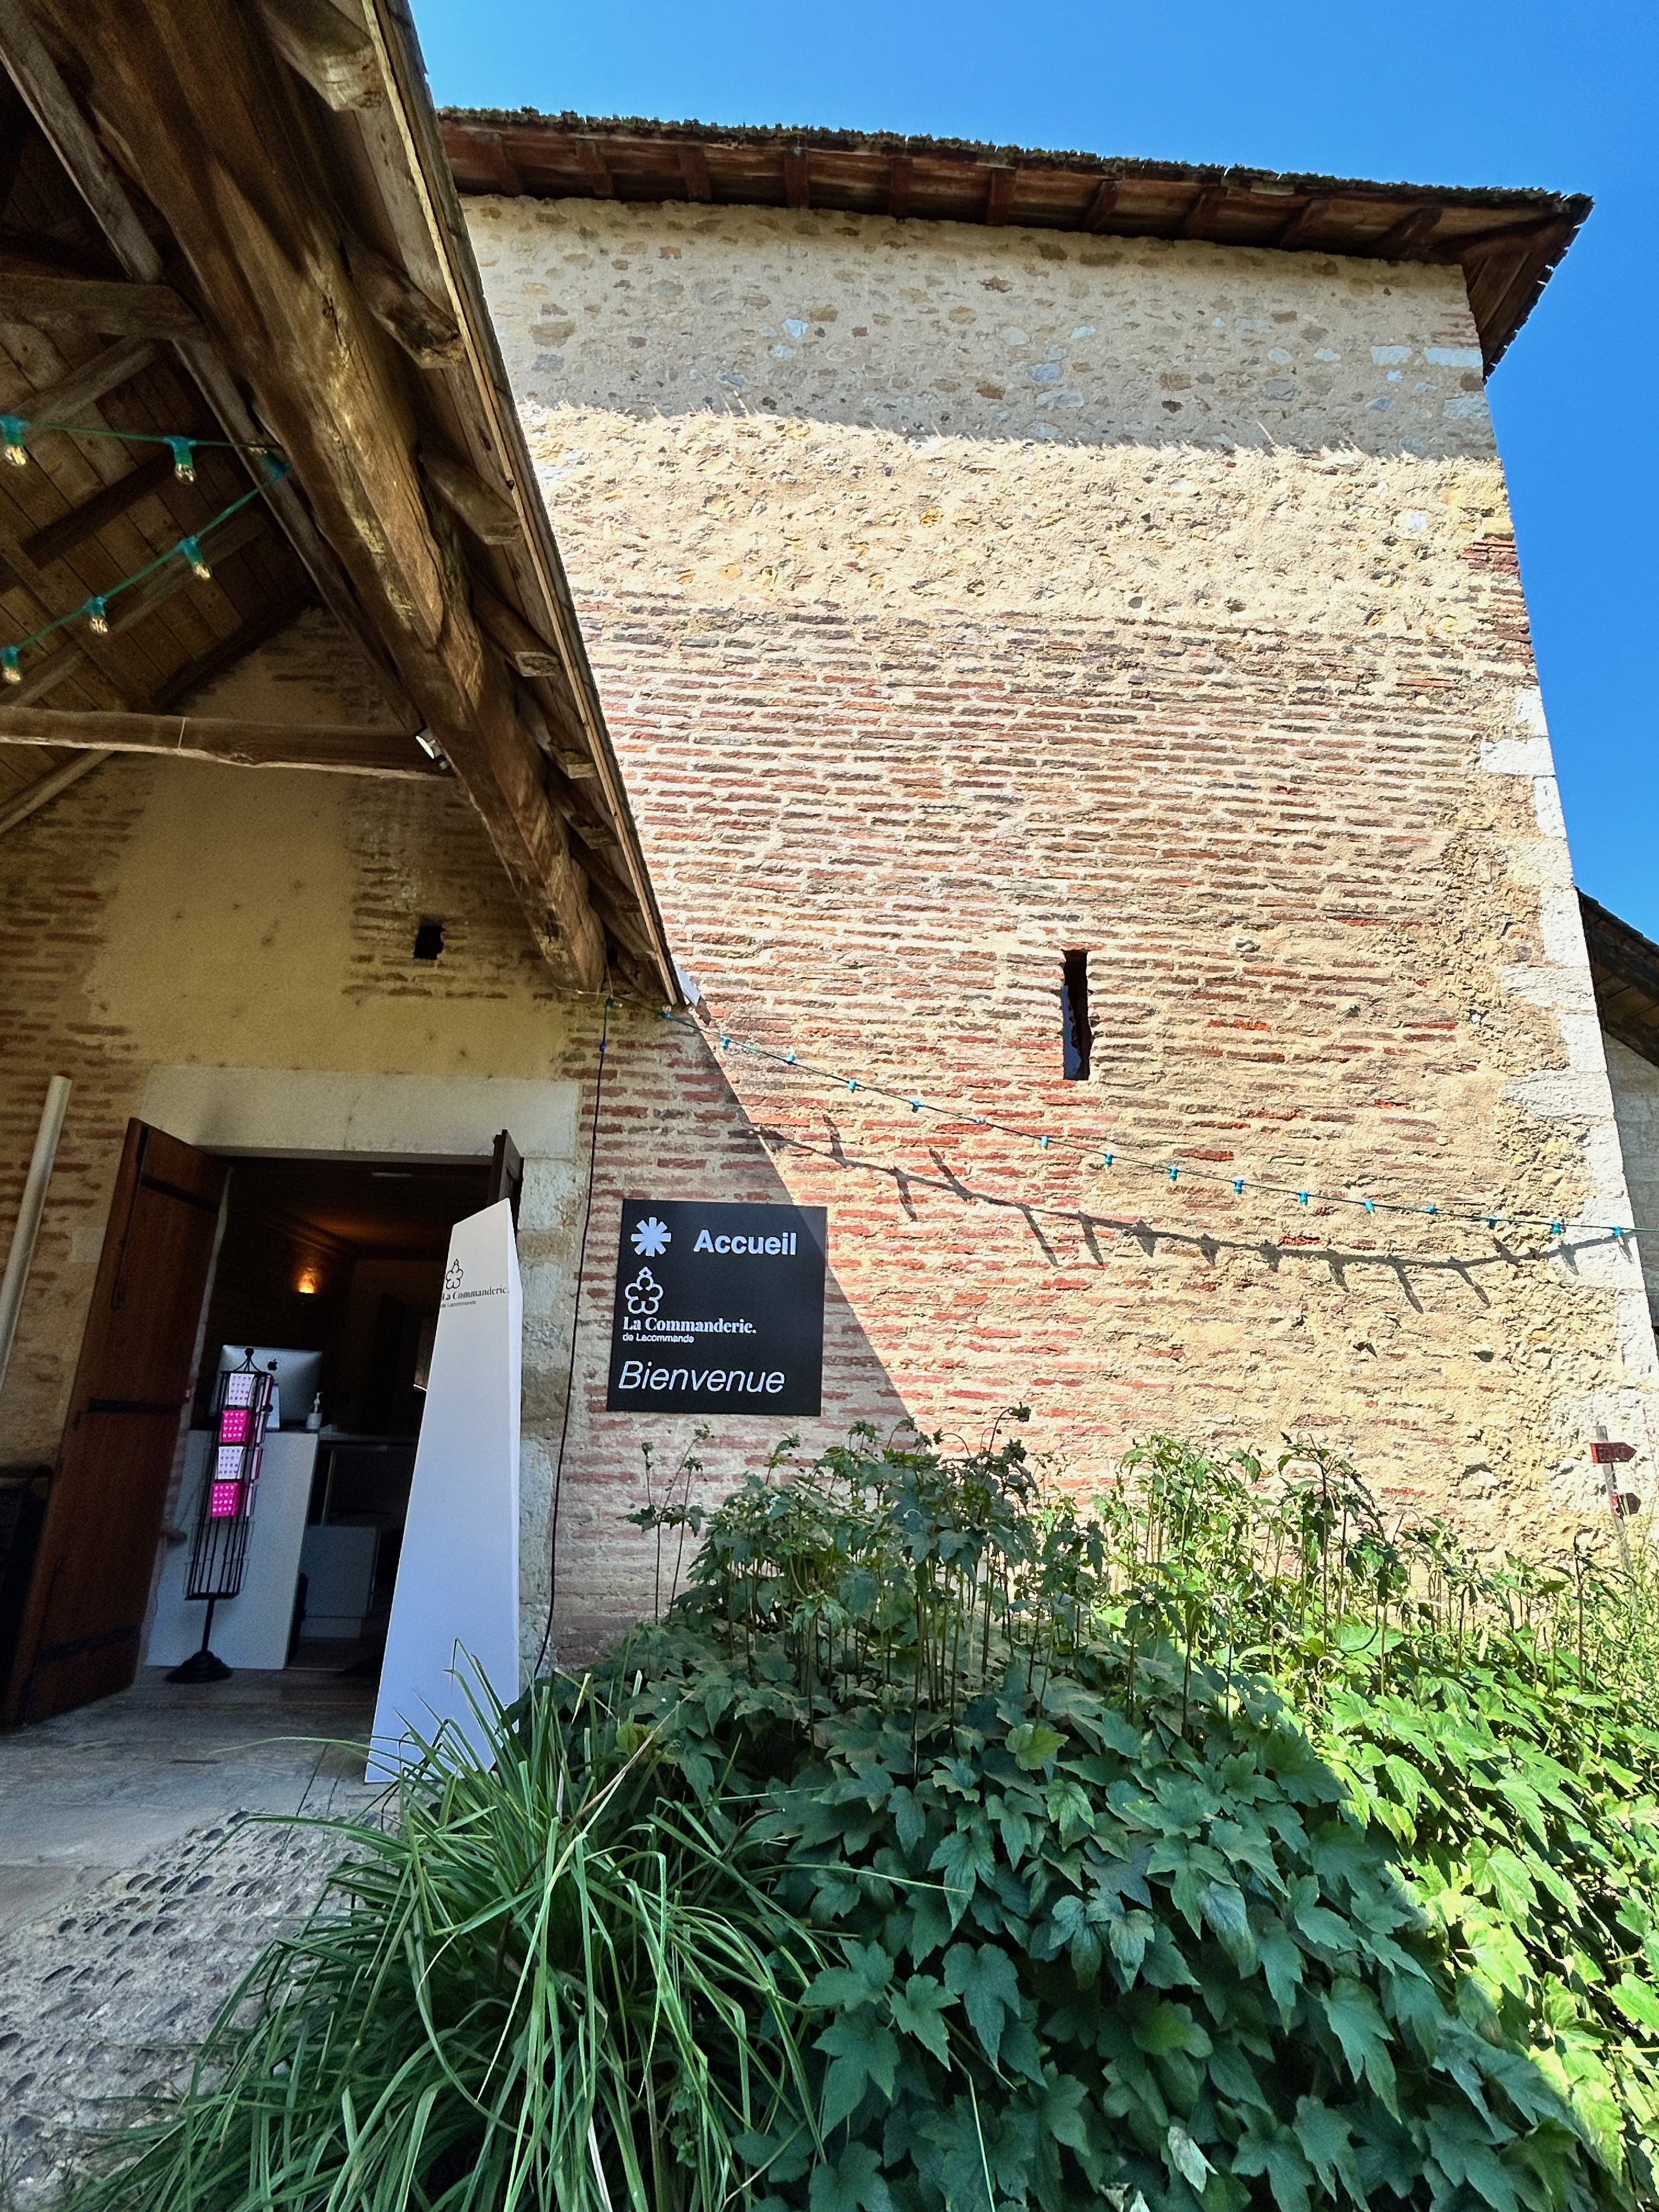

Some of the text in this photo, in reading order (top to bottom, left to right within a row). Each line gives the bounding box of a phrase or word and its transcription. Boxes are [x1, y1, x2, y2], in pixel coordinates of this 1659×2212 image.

[693, 1229, 797, 1256] Accueil
[623, 1316, 757, 1334] La Commanderie.
[622, 1333, 695, 1343] de Lacommande
[618, 1361, 785, 1393] Bienvenue
